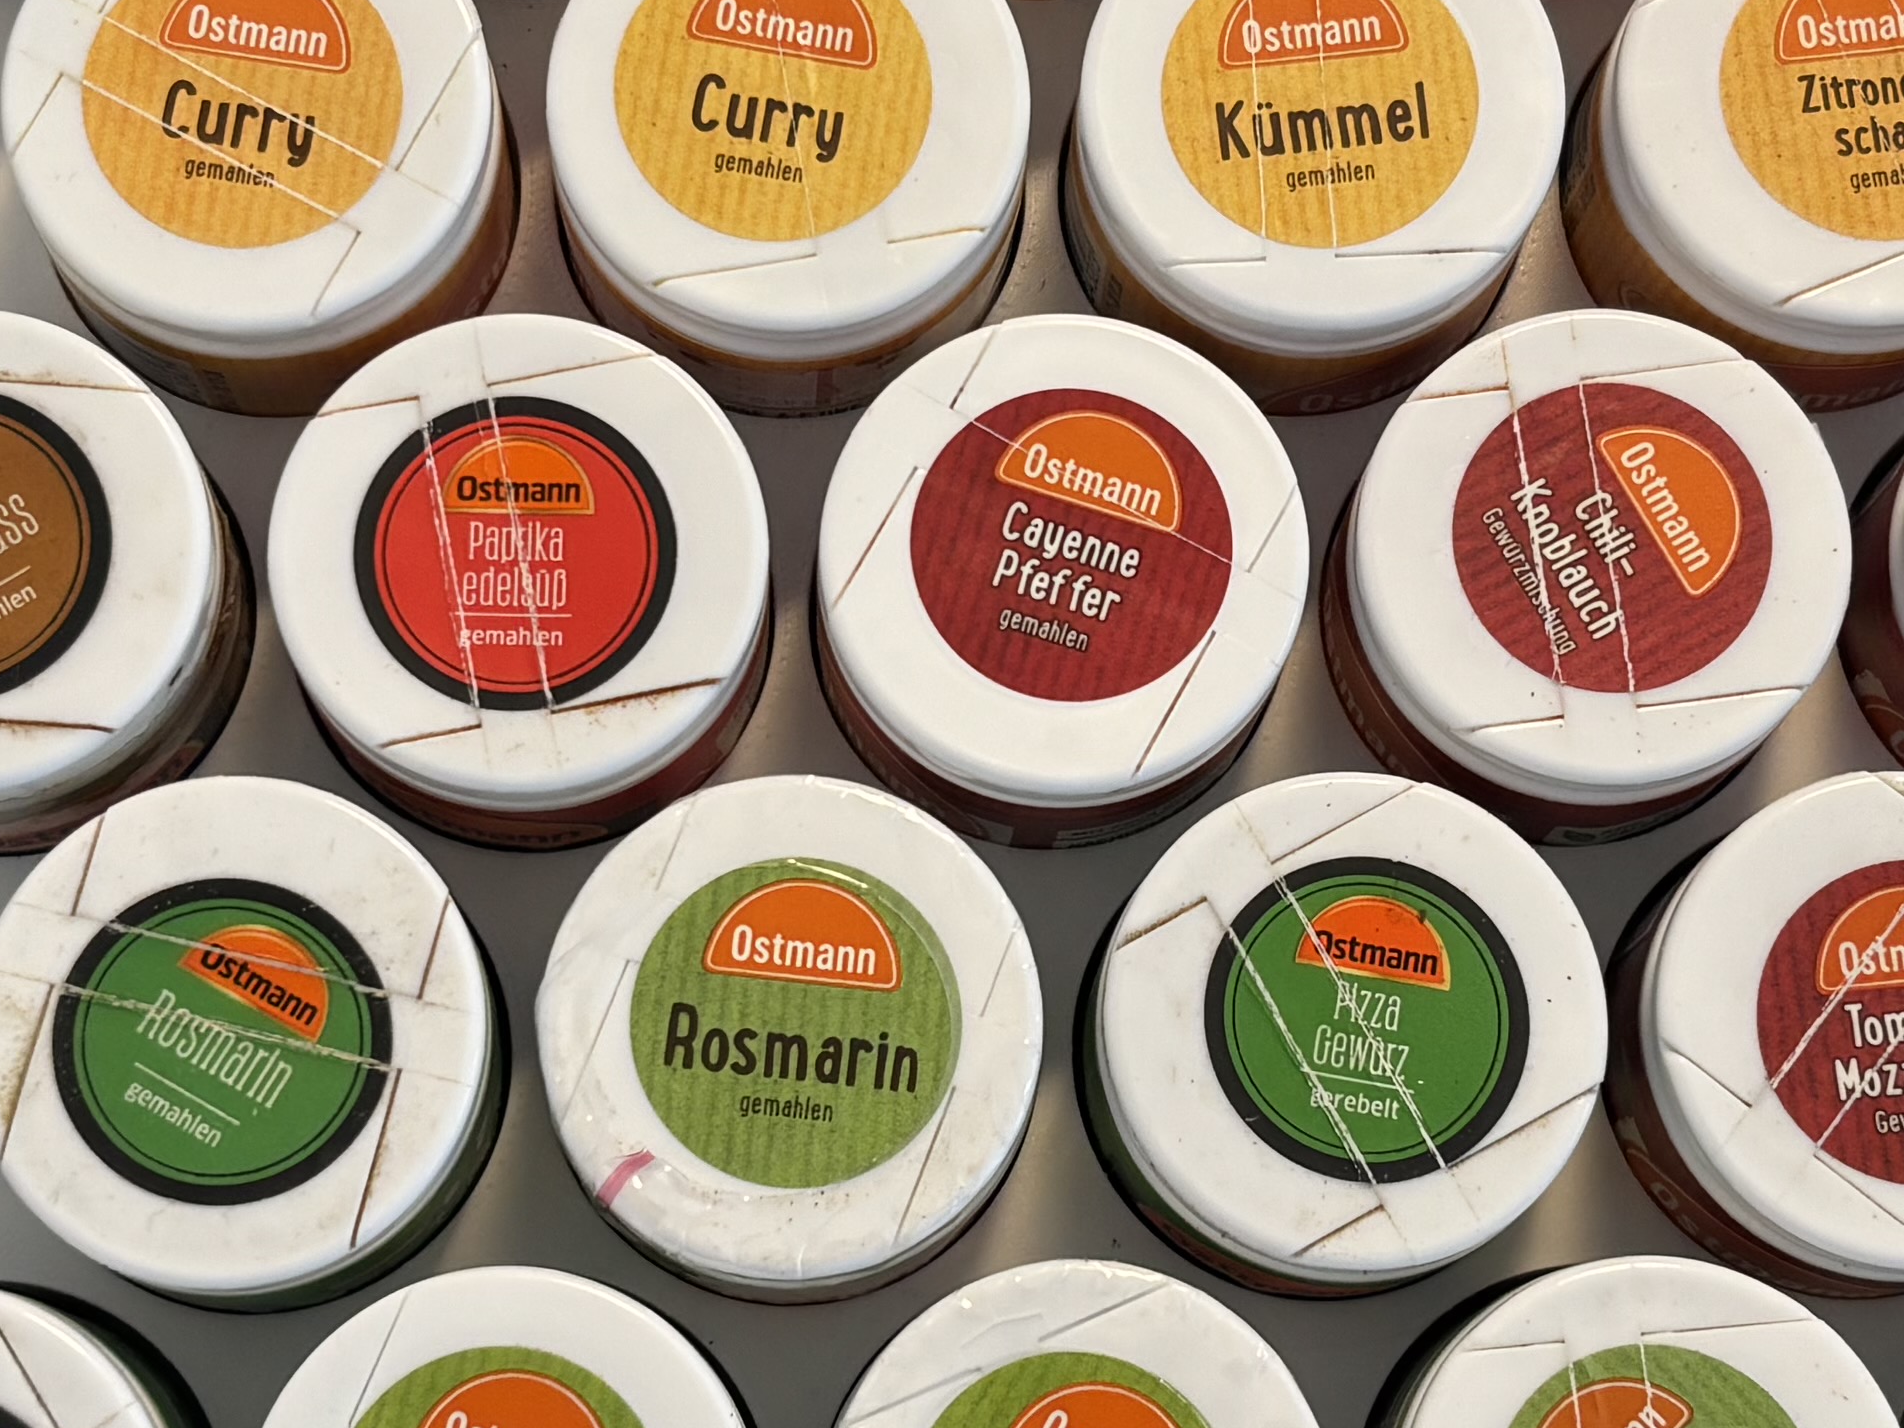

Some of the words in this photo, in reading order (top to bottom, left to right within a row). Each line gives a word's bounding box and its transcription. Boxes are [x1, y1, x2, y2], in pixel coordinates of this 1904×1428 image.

[188, 3, 328, 60] Ostmann
[1243, 13, 1382, 55] Ostmann
[161, 79, 317, 168] Curry
[691, 72, 844, 163] Curry
[1214, 80, 1432, 161] Kümmel
[184, 157, 277, 189] gemahlen
[715, 152, 805, 184] gemahlen
[1286, 160, 1376, 193] gemahlen
[457, 475, 580, 503] Ostmann
[1024, 443, 1162, 516] Ostmann
[1621, 441, 1711, 572] Ostmann
[468, 521, 564, 564] Paprika
[1002, 501, 1140, 578] Cayenne
[1510, 478, 1620, 640] Knoblauch
[1575, 491, 1637, 577] Chili-
[462, 567, 567, 610] edelsüß
[992, 549, 1120, 621] Pfeffer
[1482, 507, 1576, 656] Gewürzmischung
[460, 626, 563, 648] gemahlen
[999, 609, 1088, 651] gemahlen
[731, 924, 875, 975] Ostmann
[1314, 930, 1438, 976] Ostmann
[199, 943, 318, 1026] Ostmann
[1333, 981, 1401, 1032] Pizza
[136, 988, 293, 1111] Rosmarin
[664, 1001, 918, 1094] Rosmarin
[124, 1082, 222, 1147] gemahlen
[739, 1094, 834, 1122] gemahlen
[1310, 1087, 1400, 1120] gerebelt
